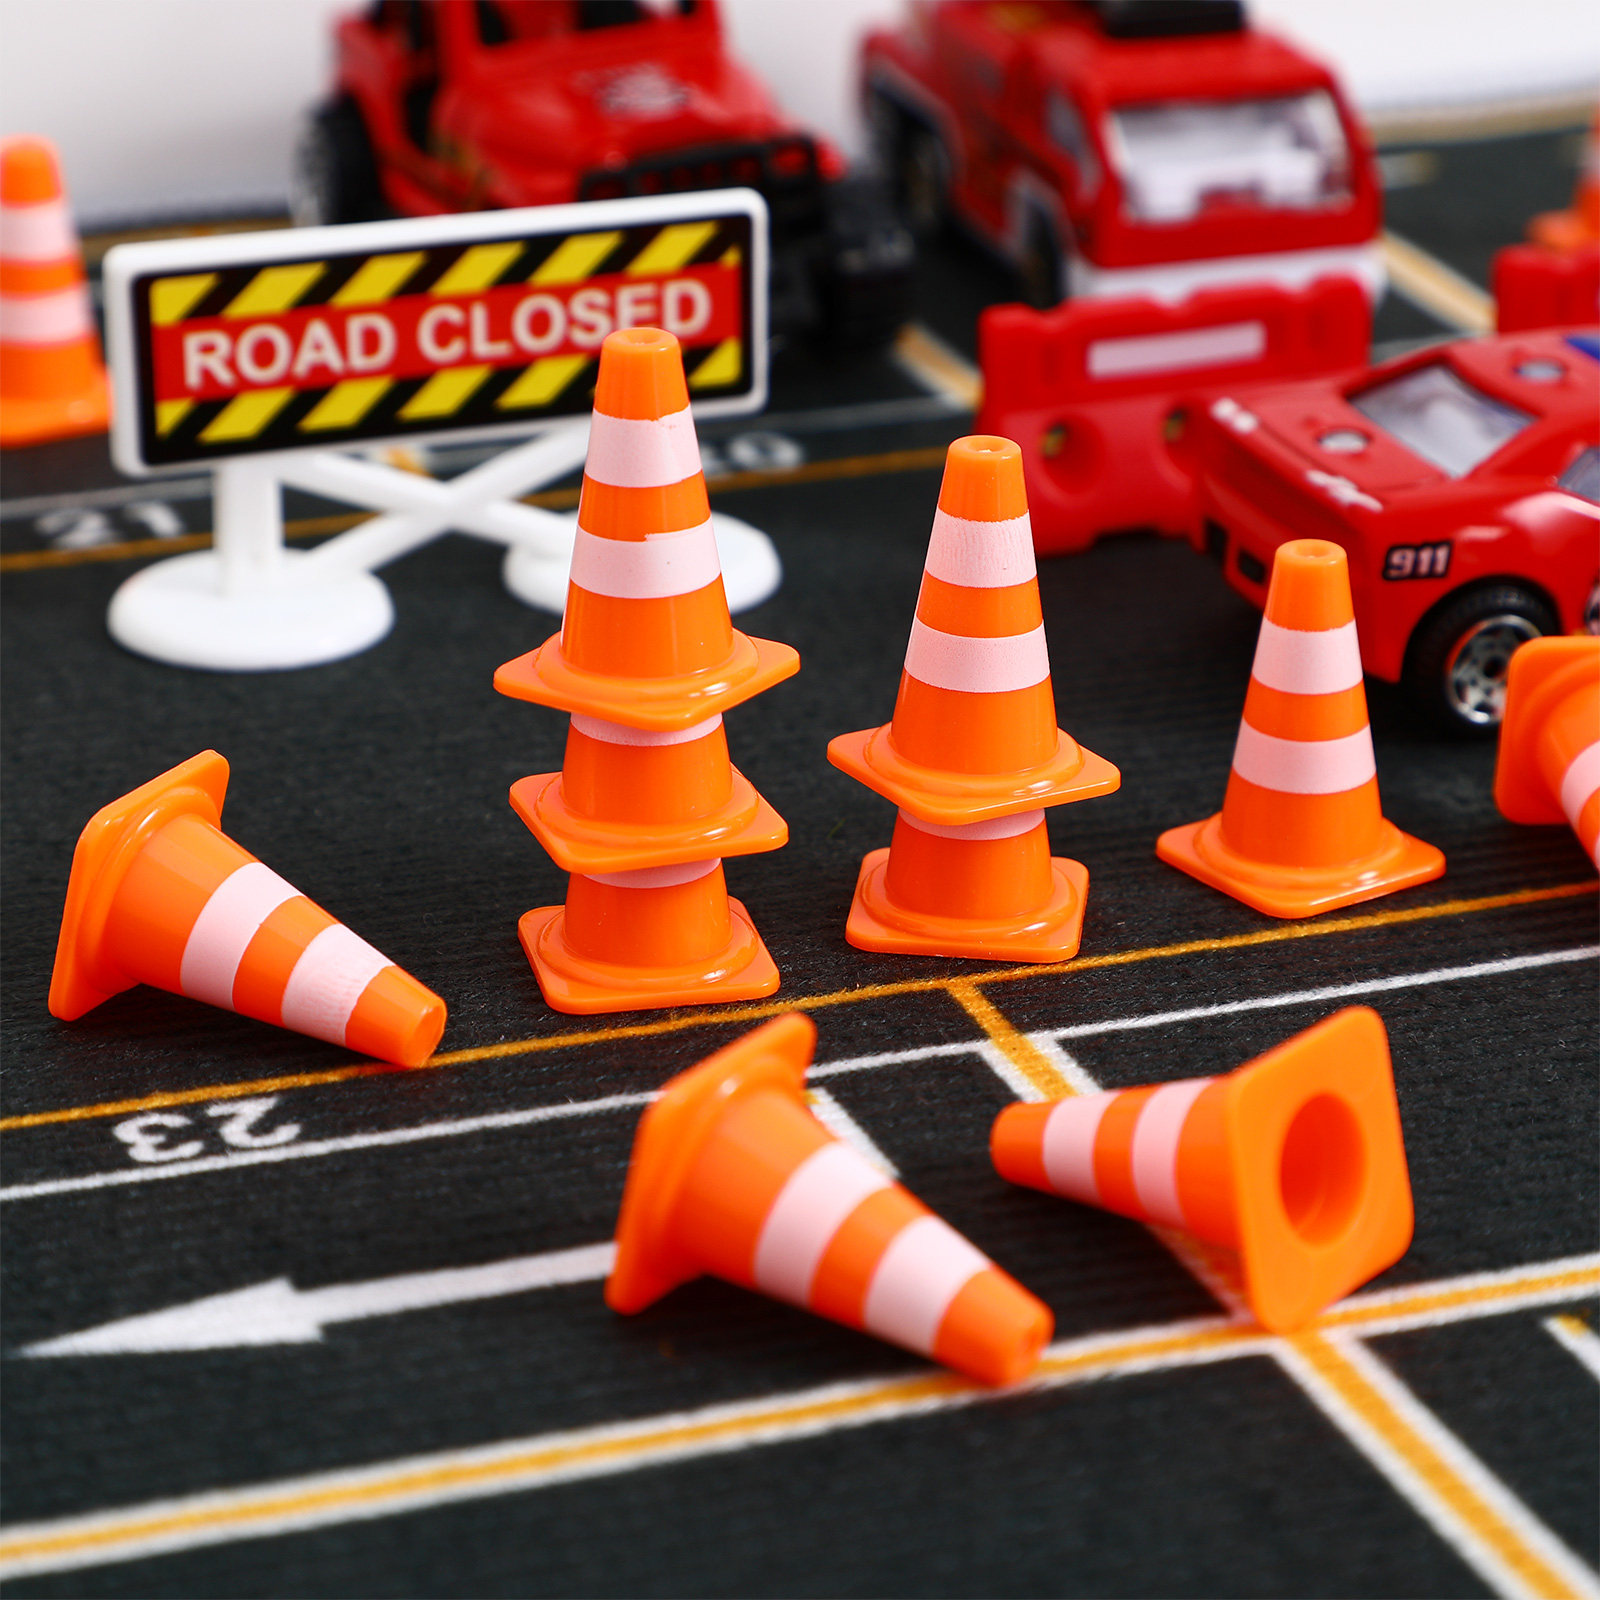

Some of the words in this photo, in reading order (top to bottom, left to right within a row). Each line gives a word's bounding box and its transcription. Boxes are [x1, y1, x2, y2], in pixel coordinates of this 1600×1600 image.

[183, 312, 397, 389] ROAD
[416, 279, 711, 363] CLOSED
[1386, 543, 1451, 578] 911
[112, 1096, 301, 1162] 23
